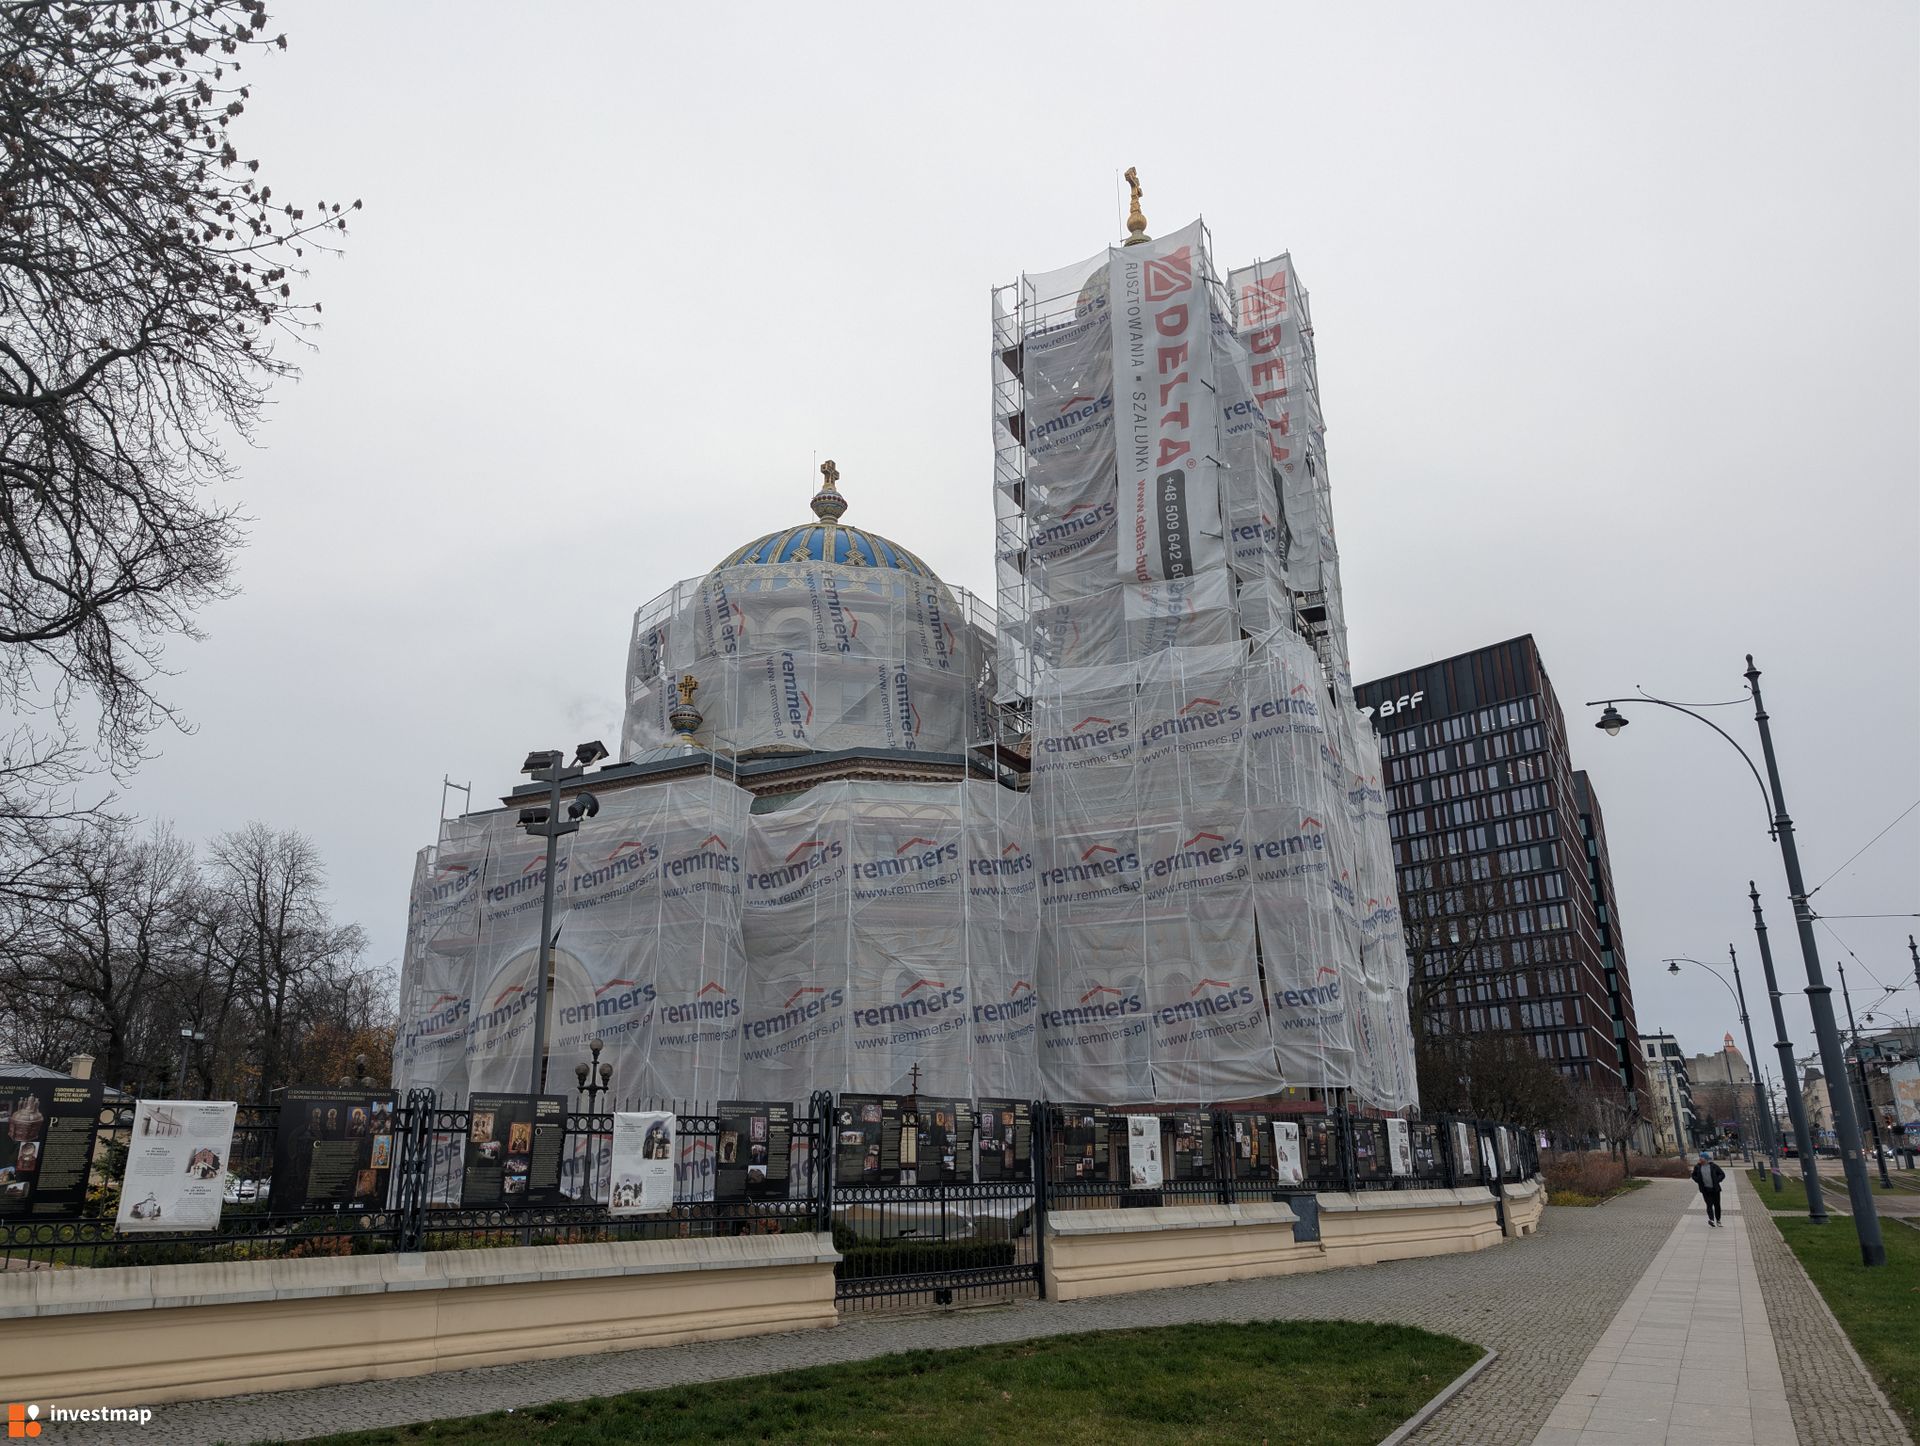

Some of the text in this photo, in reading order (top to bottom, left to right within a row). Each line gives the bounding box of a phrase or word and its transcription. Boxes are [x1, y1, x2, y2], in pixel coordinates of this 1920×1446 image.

[1125, 262, 1149, 472] RUSZTOWANIA SZALUNKI
[1155, 304, 1191, 467] DELTA
[1029, 394, 1112, 441] remmers
[1164, 477, 1177, 501] +48
[1028, 502, 1115, 550] remmers
[1165, 505, 1179, 530] 509
[1167, 533, 1182, 560] 642
[711, 571, 737, 654] remmers
[822, 570, 850, 653] remmers
[926, 585, 949, 669] remmers
[767, 656, 786, 740] www.remmers.pl
[782, 651, 805, 740] remmers
[894, 664, 916, 750] remmers
[1380, 690, 1424, 717] BFF
[1036, 721, 1129, 756] remmers
[1141, 705, 1241, 747] remmers
[1141, 727, 1243, 765] www.remmers.pl
[1036, 744, 1132, 774] www.remmers.pl
[487, 856, 568, 903] remmes
[573, 843, 659, 892] remmers
[663, 852, 740, 879] remmers
[747, 840, 843, 891] remmers
[854, 841, 959, 879] remmers
[969, 853, 1032, 876] remmers
[1041, 852, 1139, 887] remmers
[1143, 838, 1244, 882] remmers
[664, 881, 741, 899] www.remmers.pl
[855, 868, 961, 900] www.remmers.pl
[1043, 878, 1142, 906] www.remmers.pl
[1145, 865, 1249, 900] www.remmers.pl
[559, 983, 657, 1026] remmers
[660, 998, 741, 1025] remmers
[743, 988, 844, 1041] remmers
[854, 986, 965, 1028] remmers
[1040, 993, 1142, 1030] remmers
[1151, 985, 1254, 1028] remmers
[743, 1015, 844, 1062] www.remmers.pl
[854, 1015, 968, 1050] www.remmers.pl
[1044, 1020, 1146, 1049] www.remmers.pl
[1156, 1011, 1263, 1050] www.remmers.pl
